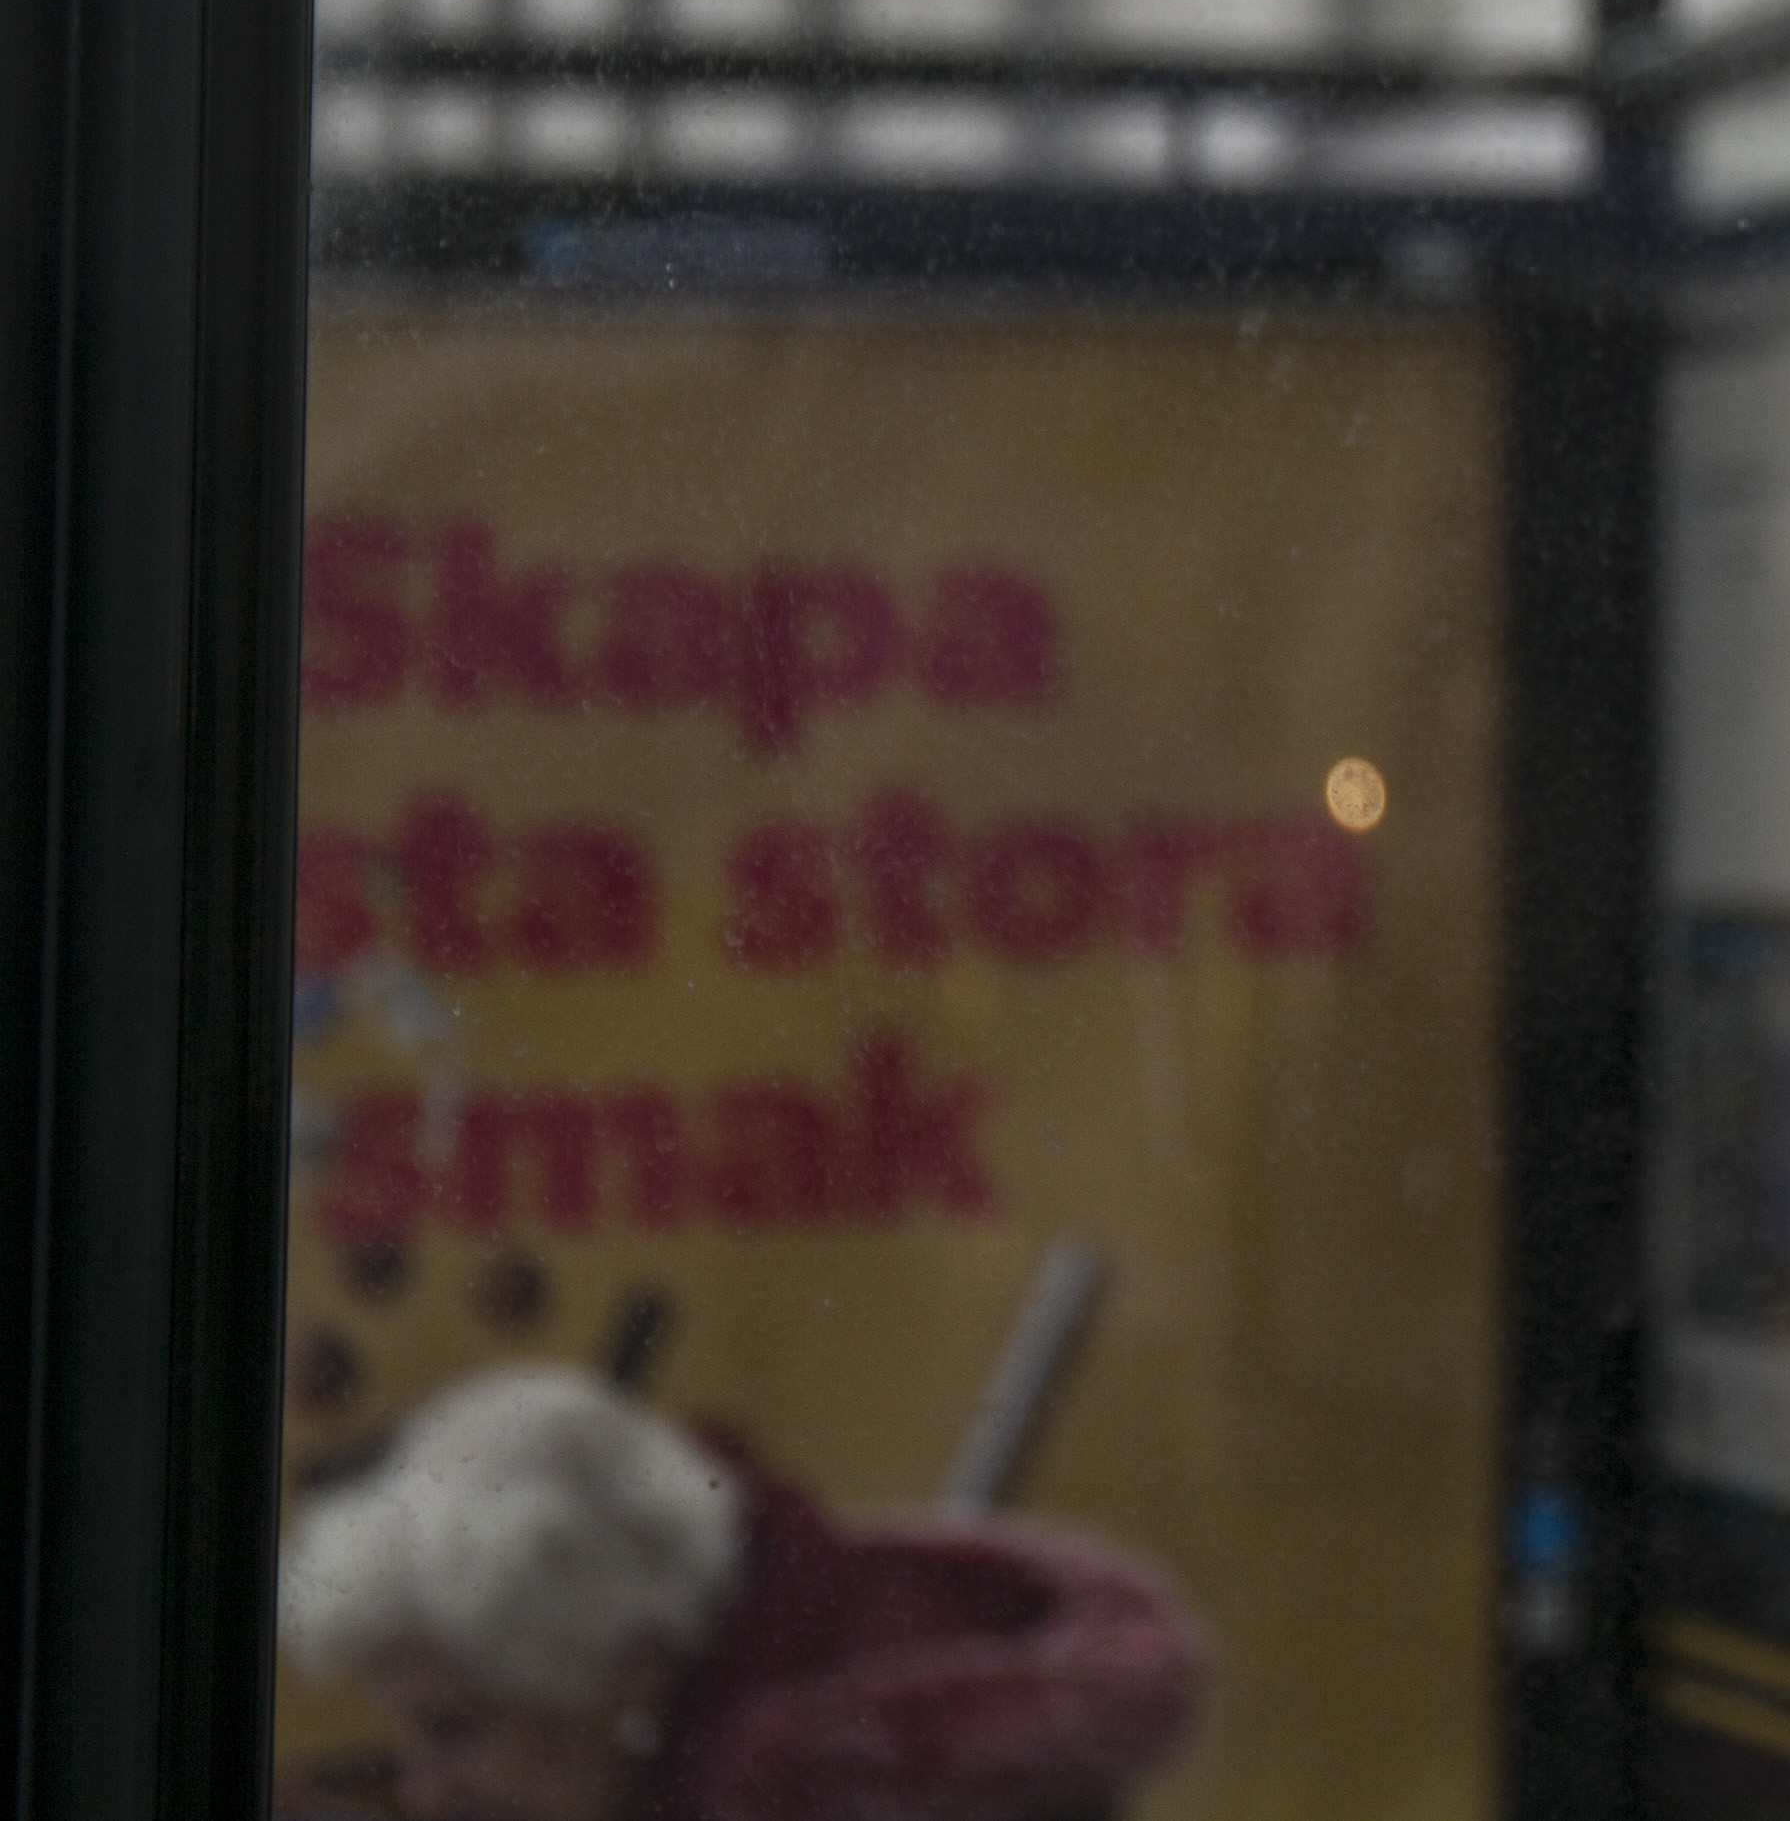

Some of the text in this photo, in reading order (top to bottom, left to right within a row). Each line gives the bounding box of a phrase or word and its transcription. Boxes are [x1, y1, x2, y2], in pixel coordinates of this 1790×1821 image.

[301, 515, 1058, 753] Skapa
[725, 787, 1367, 963] stora
[320, 1031, 992, 1239] smak
